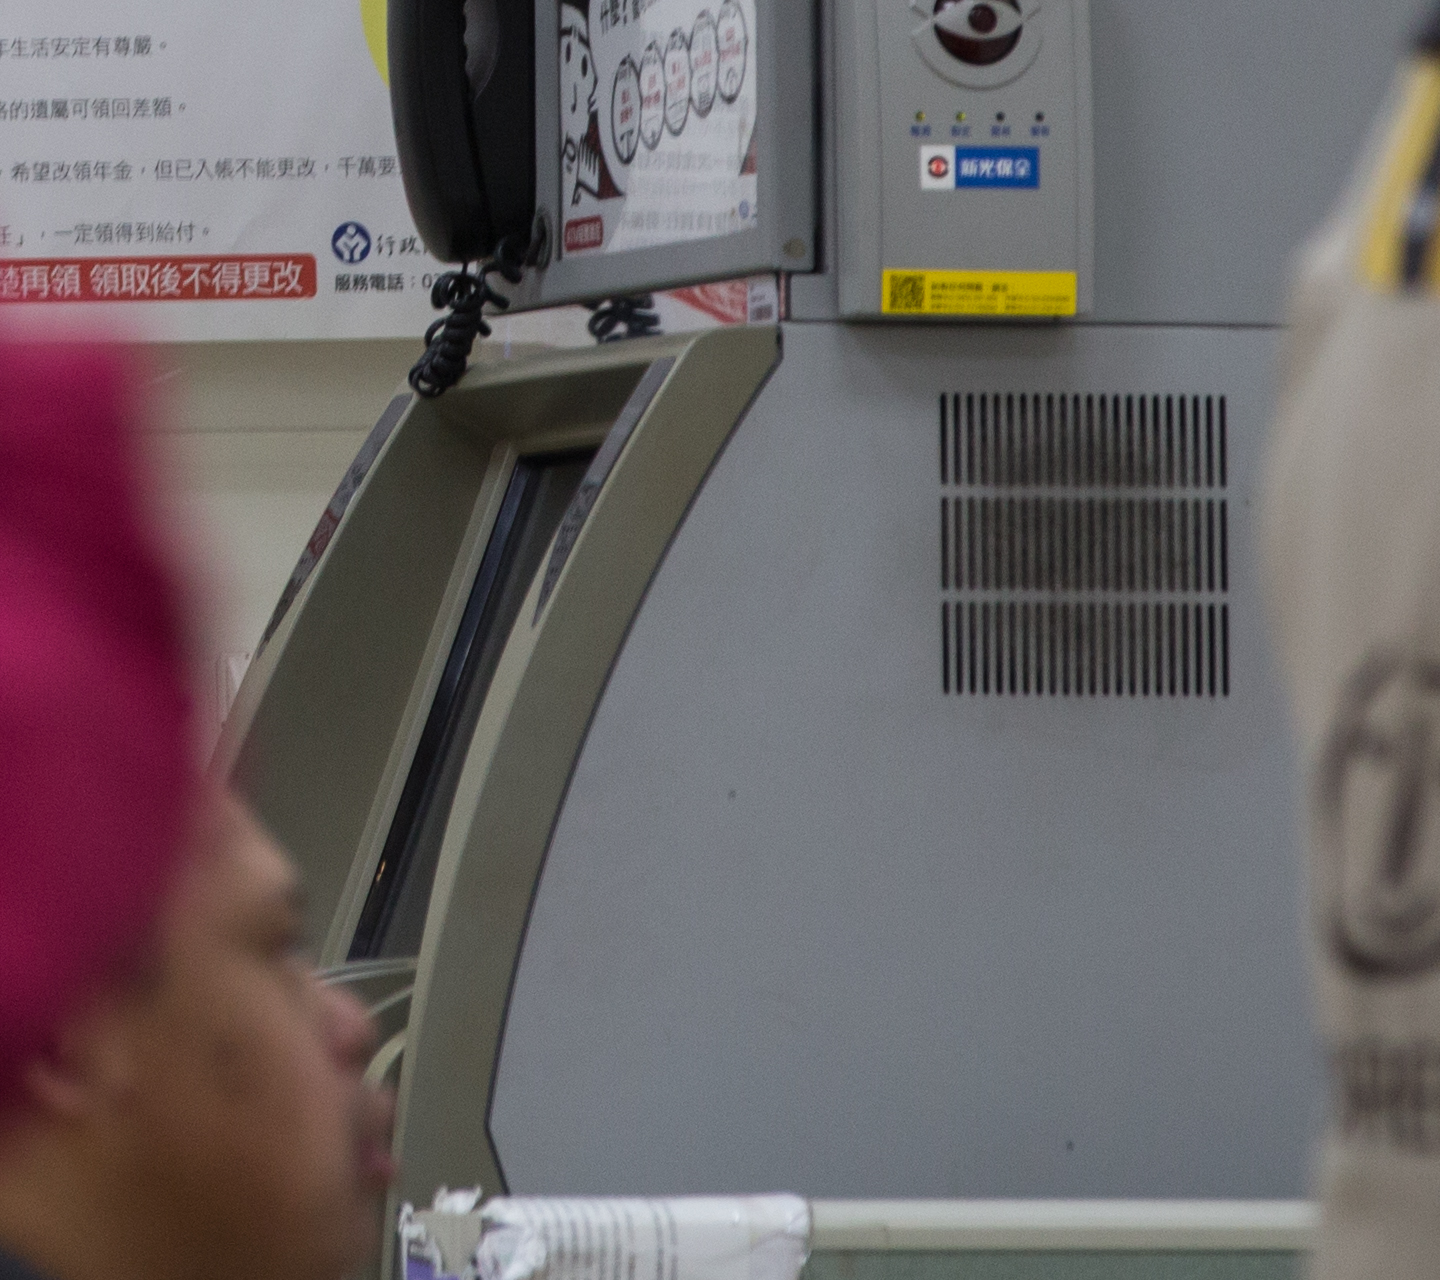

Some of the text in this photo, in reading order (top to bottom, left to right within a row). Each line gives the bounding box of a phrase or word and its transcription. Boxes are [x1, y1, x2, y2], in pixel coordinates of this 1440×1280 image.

[960, 157, 1031, 179] 新光保全
[376, 233, 427, 257] 行政
[90, 259, 304, 297] 領取後不得更改
